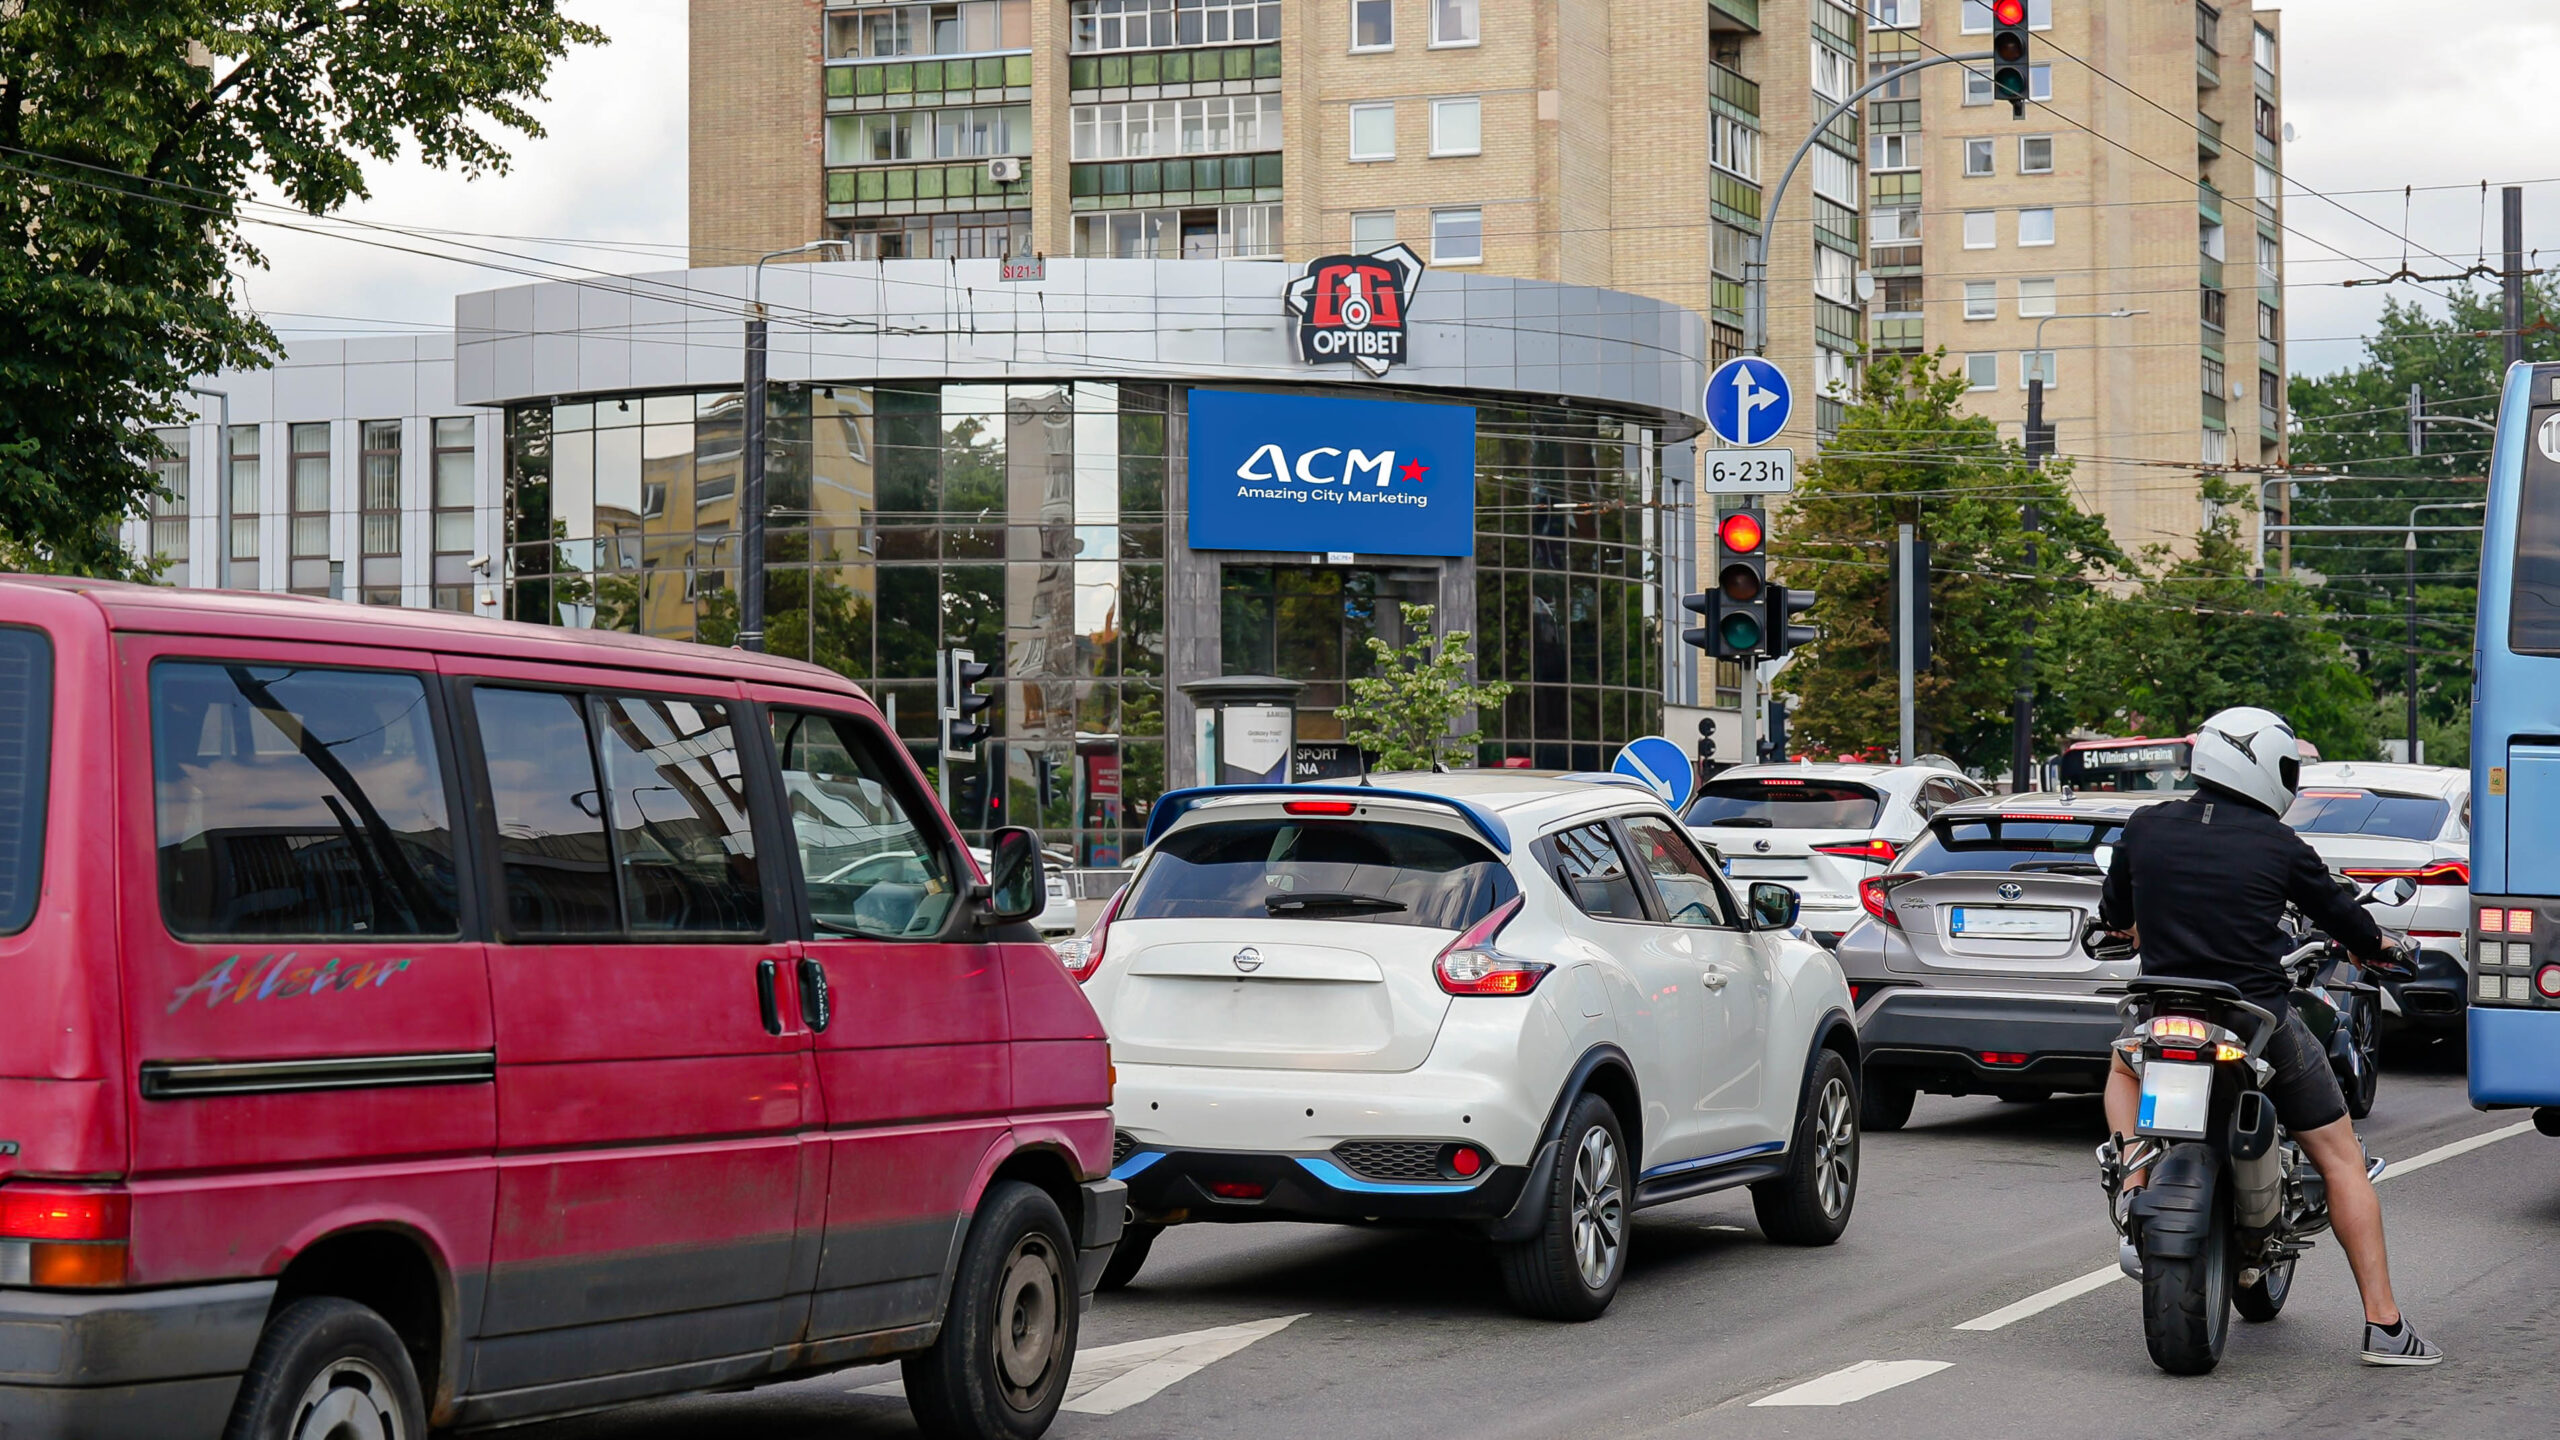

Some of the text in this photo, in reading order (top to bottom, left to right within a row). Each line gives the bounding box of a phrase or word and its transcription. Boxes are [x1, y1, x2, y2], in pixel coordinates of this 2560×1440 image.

[1016, 264, 1043, 278] 21-1
[1313, 330, 1402, 355] OPTIBET
[1236, 443, 1396, 487] ACM
[1712, 460, 1785, 482] 6-23h
[1237, 486, 1428, 508] Amazing City Marketing
[1296, 748, 1338, 761] SPORT
[2083, 748, 2173, 769] 54 Vilnius Ukraina
[2140, 1119, 2151, 1127] LT
